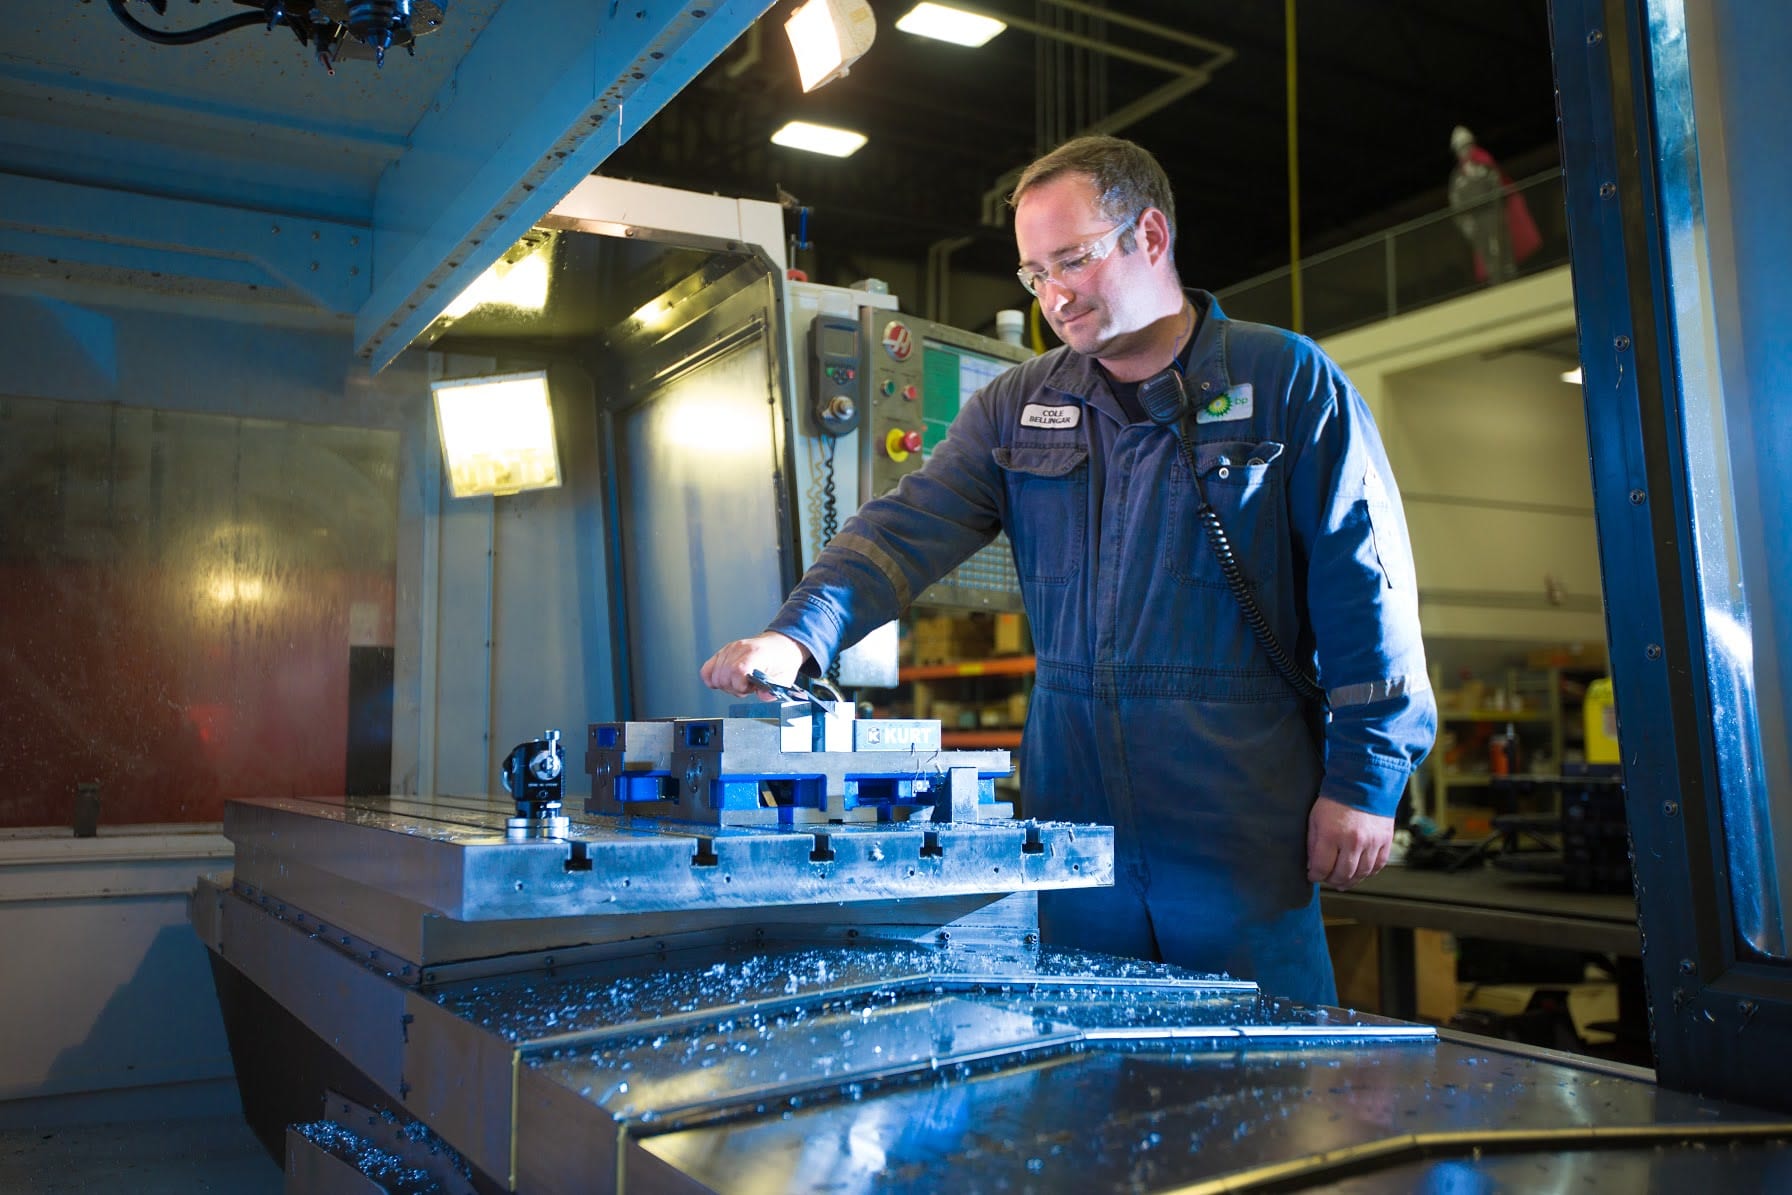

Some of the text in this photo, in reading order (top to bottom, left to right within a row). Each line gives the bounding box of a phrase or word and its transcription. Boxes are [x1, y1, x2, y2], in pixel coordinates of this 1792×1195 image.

[1235, 397, 1248, 406] bp
[1042, 409, 1064, 417] COLE
[884, 727, 931, 744] KURT
